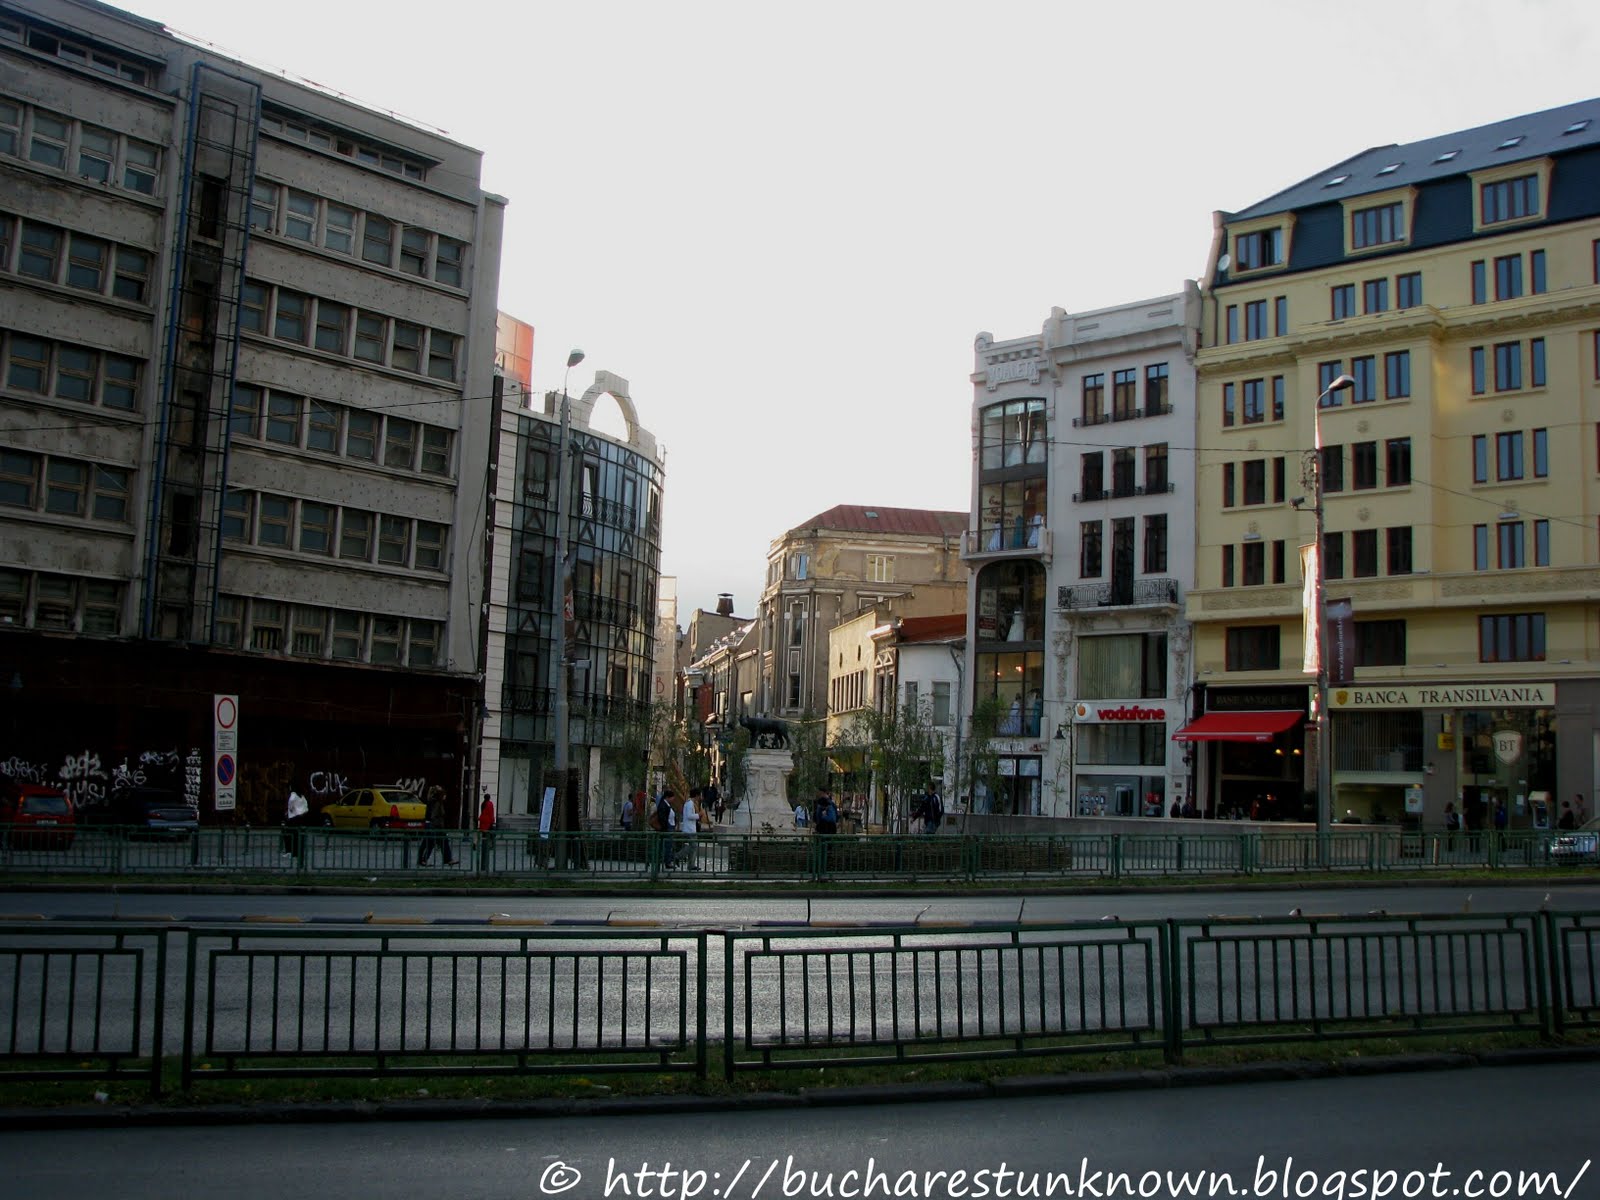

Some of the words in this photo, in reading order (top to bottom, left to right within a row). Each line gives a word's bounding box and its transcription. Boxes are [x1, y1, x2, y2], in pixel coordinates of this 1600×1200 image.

[1353, 690, 1409, 704] BANCA
[1418, 688, 1545, 703] TRANSILVANIA
[1097, 705, 1166, 721] vodafone
[1499, 739, 1516, 751] BT
